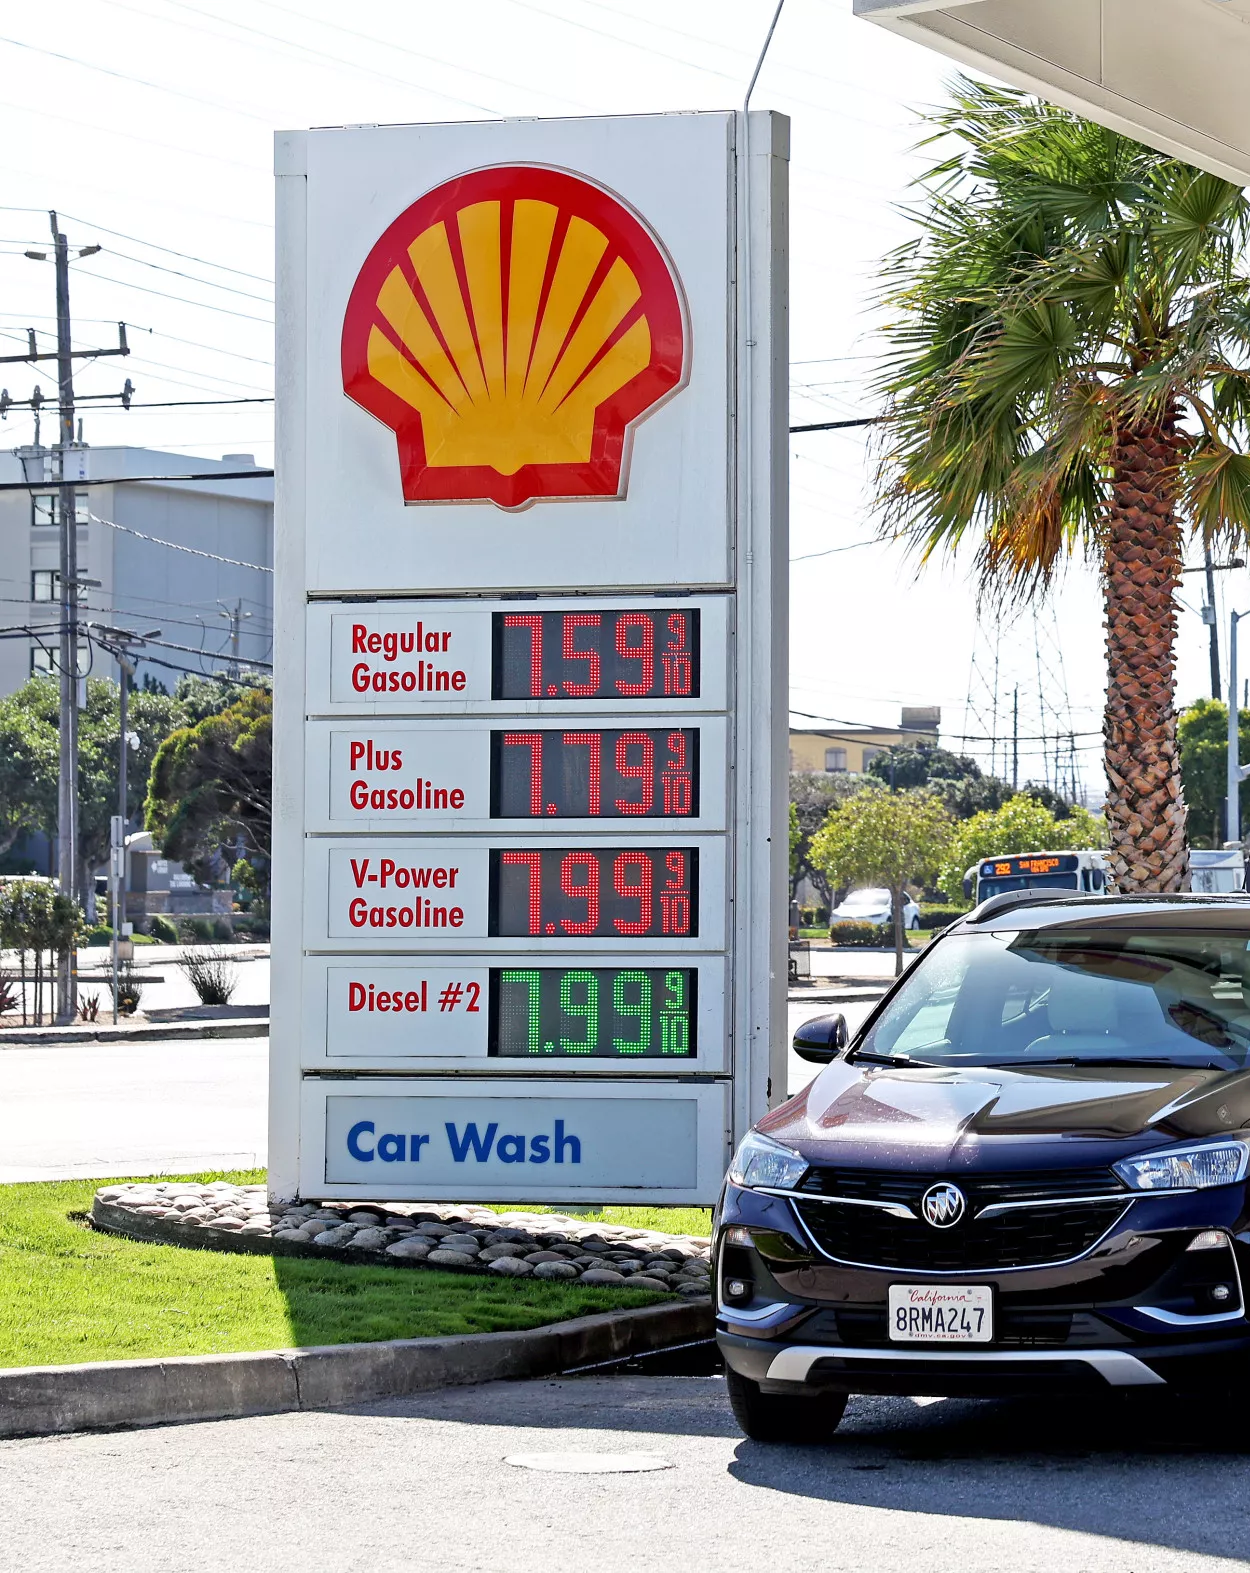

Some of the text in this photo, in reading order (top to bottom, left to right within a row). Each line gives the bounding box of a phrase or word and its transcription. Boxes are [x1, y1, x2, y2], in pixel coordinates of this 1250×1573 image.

[352, 621, 452, 662] Regular
[504, 614, 655, 697] 7.59
[352, 661, 466, 693] Gasoline
[350, 739, 403, 772] Plus
[504, 732, 655, 815] 7.79
[350, 778, 465, 810] Gasoline
[351, 858, 460, 890] V-Power
[995, 863, 1011, 875] 292
[502, 851, 654, 935] 7.99
[349, 897, 464, 928] Gasoline
[349, 981, 481, 1013] Diesel #2
[502, 970, 653, 1054] 7.99
[347, 1119, 582, 1164] Car Wash
[910, 1289, 968, 1305] California
[896, 1307, 985, 1332] 8RMA247
